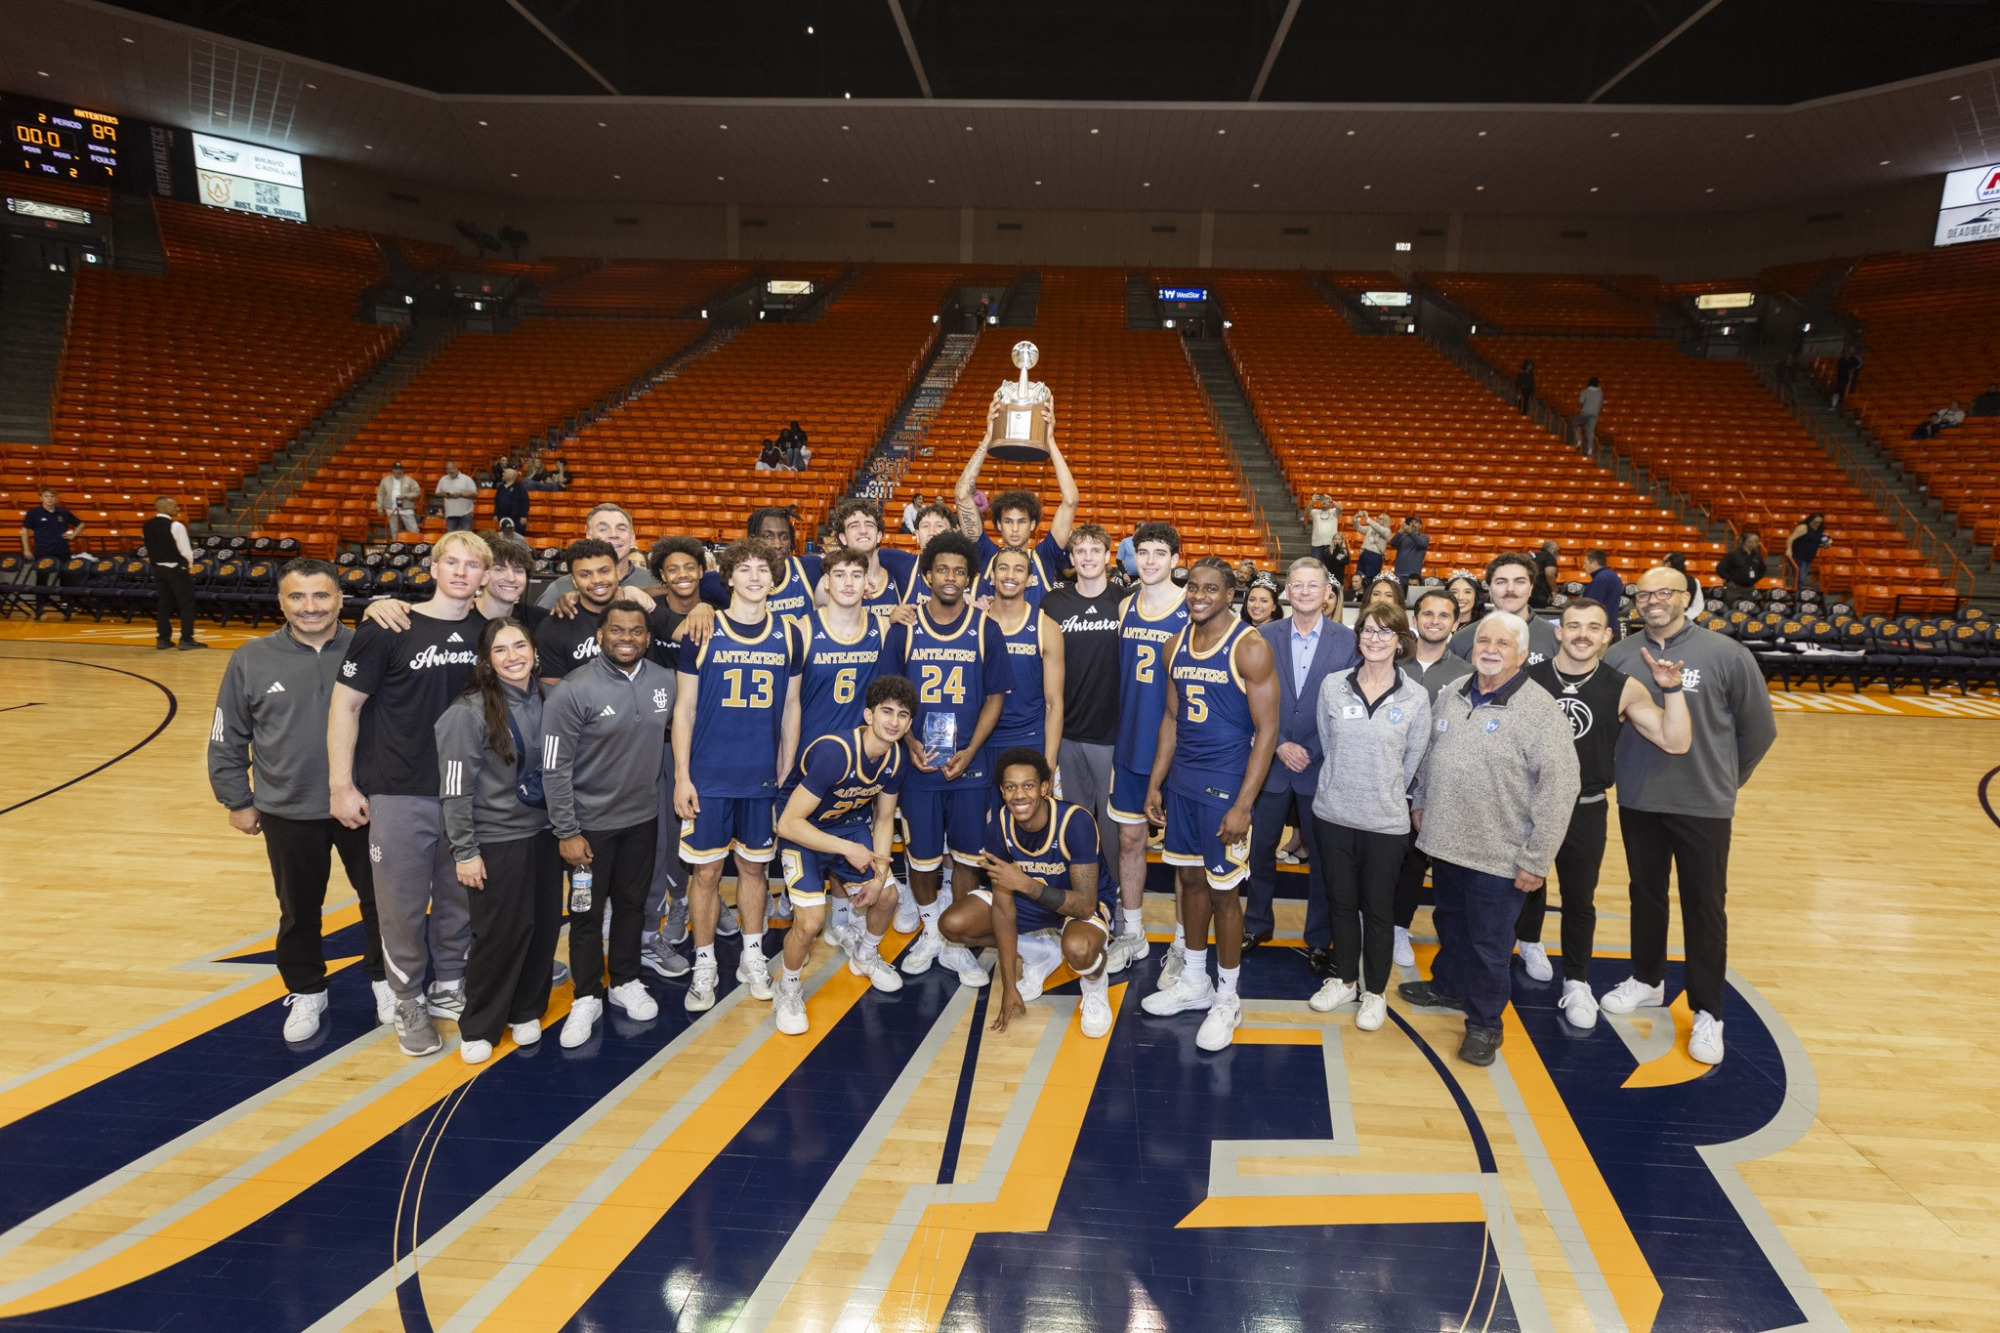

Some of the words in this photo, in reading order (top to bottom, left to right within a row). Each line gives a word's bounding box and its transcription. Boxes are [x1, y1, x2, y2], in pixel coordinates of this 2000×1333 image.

[91, 123, 117, 141] 89
[254, 156, 285, 168] BRAVO
[255, 163, 299, 178] CADILLAC
[713, 650, 785, 666] ANTEATERS
[813, 651, 879, 664] ANTEATERS
[912, 648, 977, 662] ANTEATERS
[1136, 644, 1156, 684] 2
[1172, 667, 1230, 684] ANTEATERS
[721, 668, 774, 708] 13
[833, 668, 858, 704] 6
[920, 665, 966, 704] 24
[1185, 684, 1209, 723] 5
